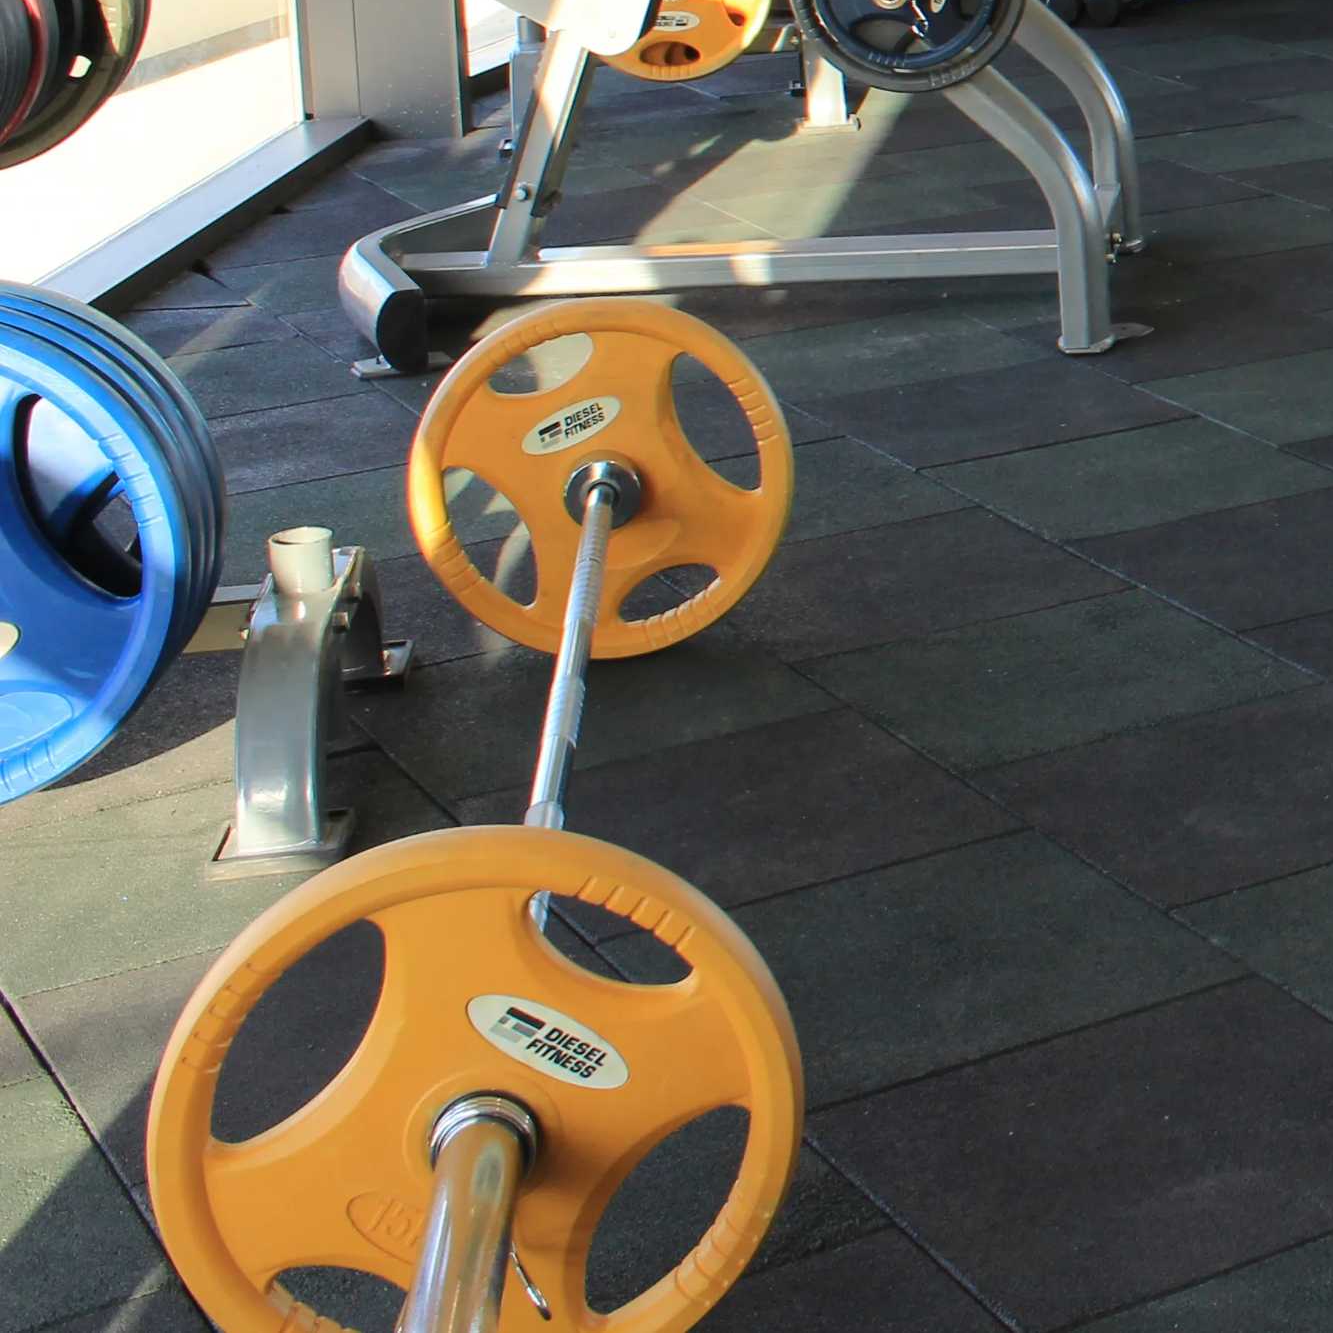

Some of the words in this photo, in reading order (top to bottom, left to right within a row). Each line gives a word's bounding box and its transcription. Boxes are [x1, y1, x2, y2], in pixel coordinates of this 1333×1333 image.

[563, 402, 603, 427] DIESEL
[564, 412, 605, 439] FITNESS
[526, 1038, 598, 1079] FITNESS
[543, 1027, 608, 1067] DIESEL
